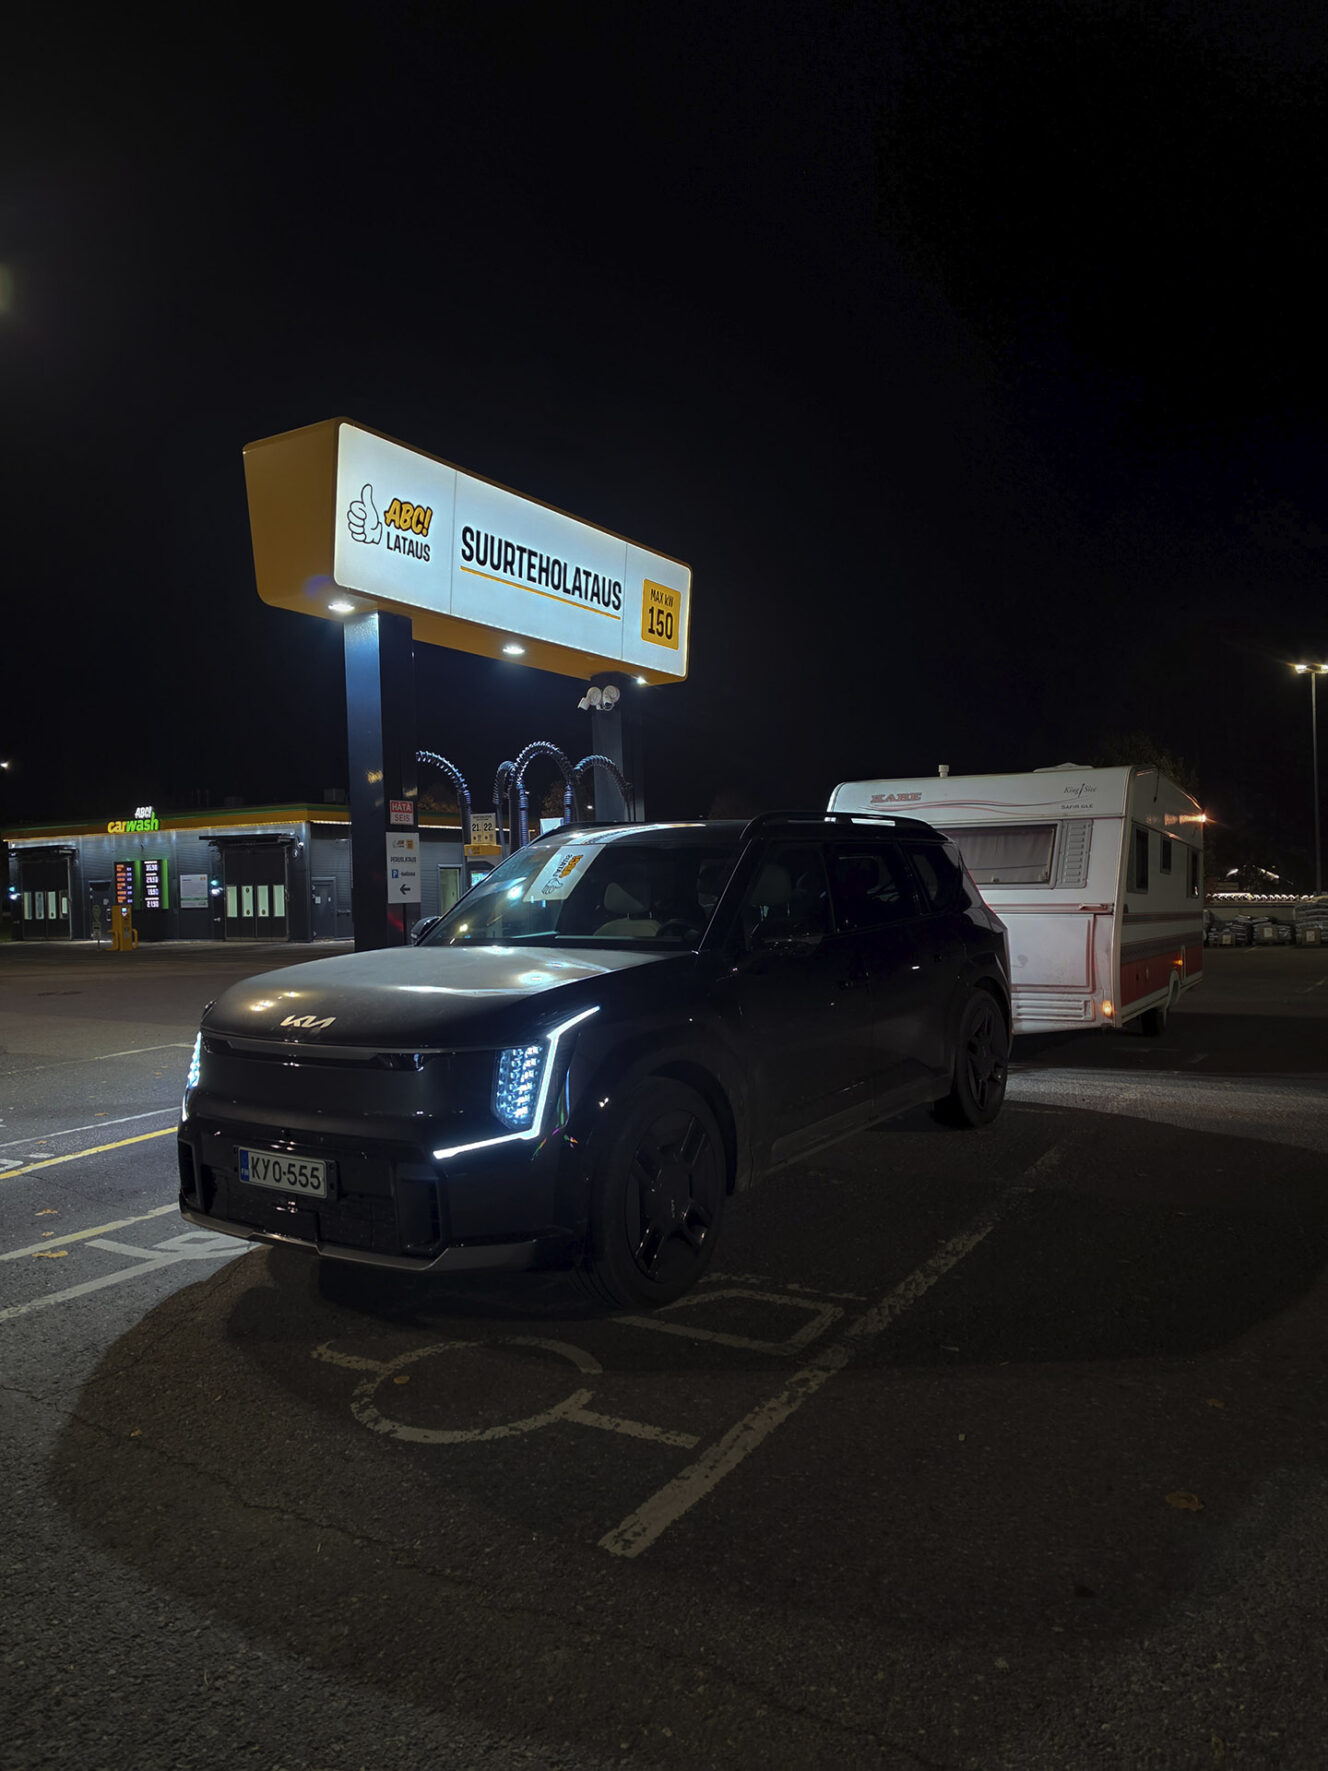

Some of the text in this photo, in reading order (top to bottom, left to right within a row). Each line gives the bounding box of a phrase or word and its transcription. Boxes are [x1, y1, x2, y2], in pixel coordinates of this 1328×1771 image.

[383, 497, 433, 537] ABC!
[387, 531, 431, 562] LATAUS
[461, 525, 622, 611] SUURTEHOLATAUS
[650, 588, 664, 605] MAX
[648, 606, 674, 640] 150
[107, 811, 159, 833] carwash
[250, 1156, 321, 1190] KYO-555
